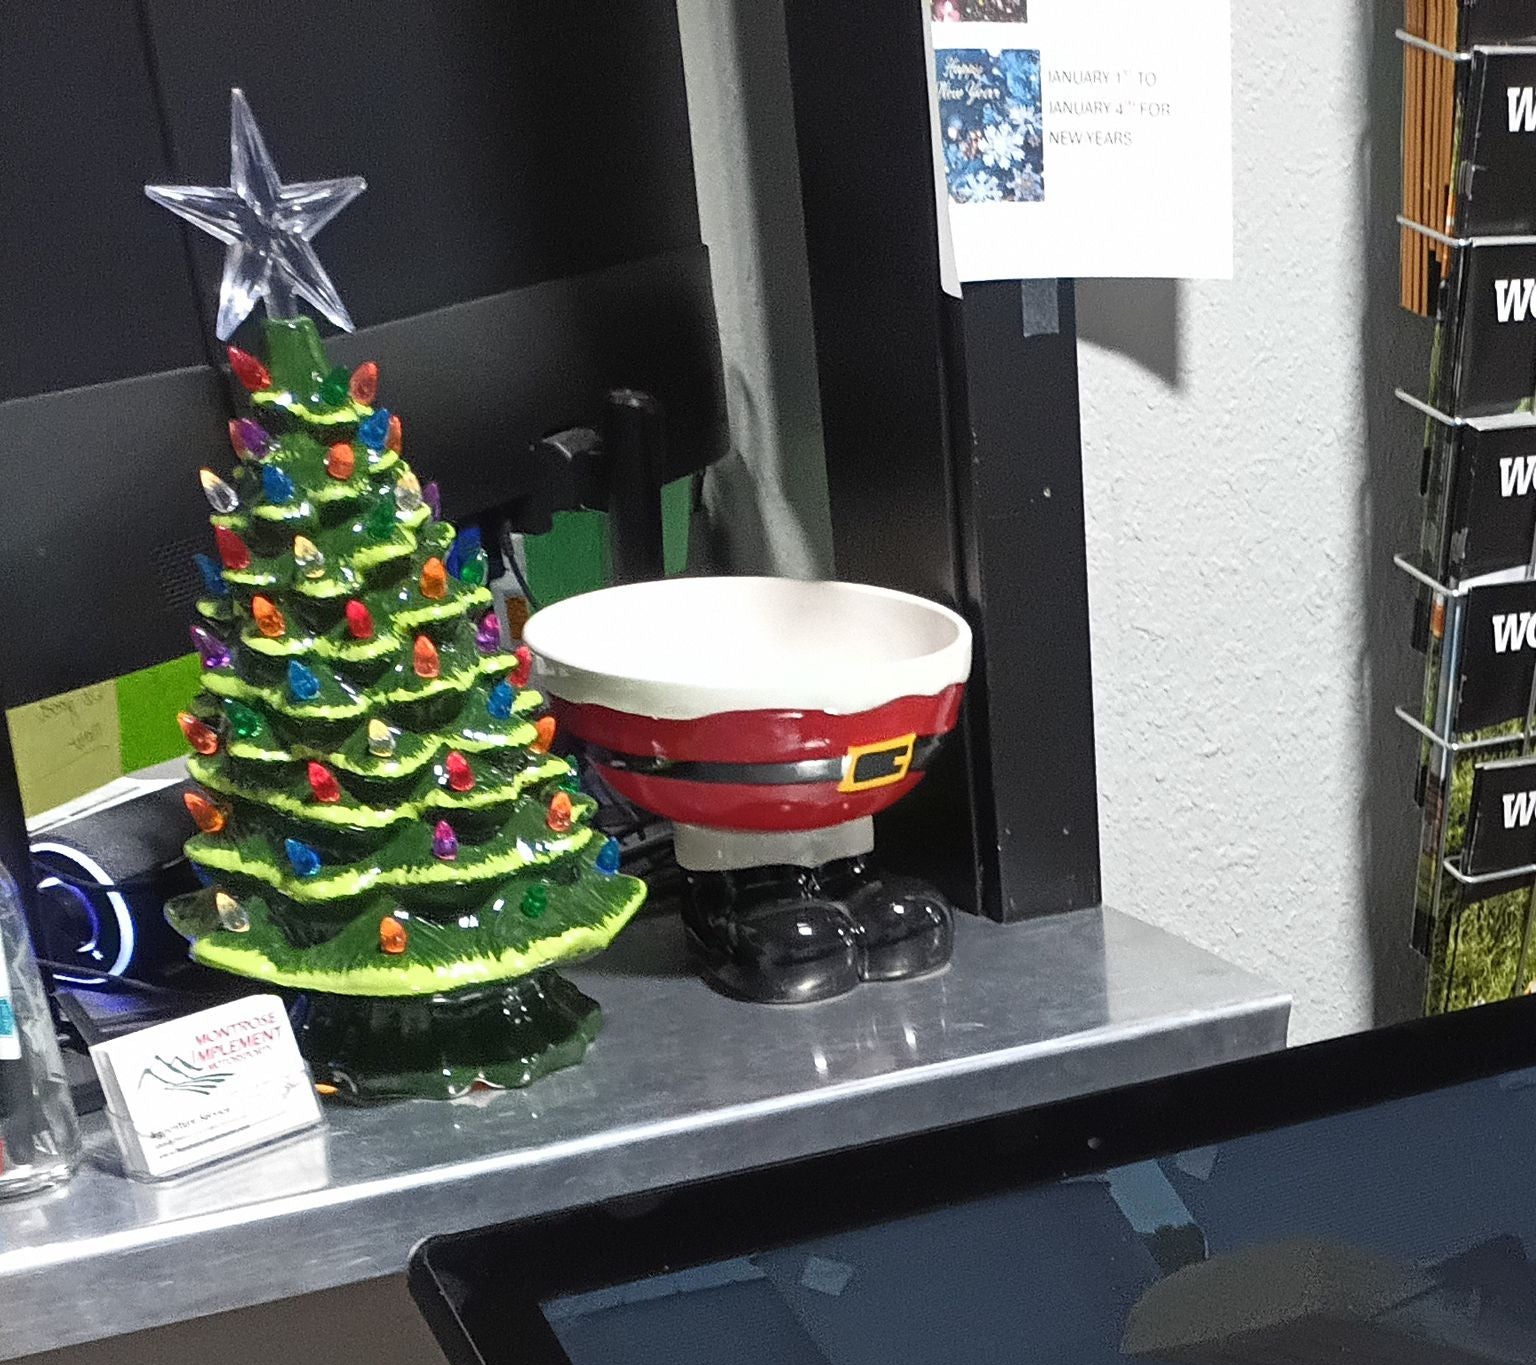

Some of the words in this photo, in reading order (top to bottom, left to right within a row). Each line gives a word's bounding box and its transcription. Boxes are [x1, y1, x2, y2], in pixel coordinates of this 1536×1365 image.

[1137, 71, 1157, 87] TO
[1139, 102, 1171, 118] FOR
[1048, 131, 1084, 146] NEW
[1086, 131, 1133, 146] YEARS
[191, 1026, 281, 1064] IMPLEMENT
